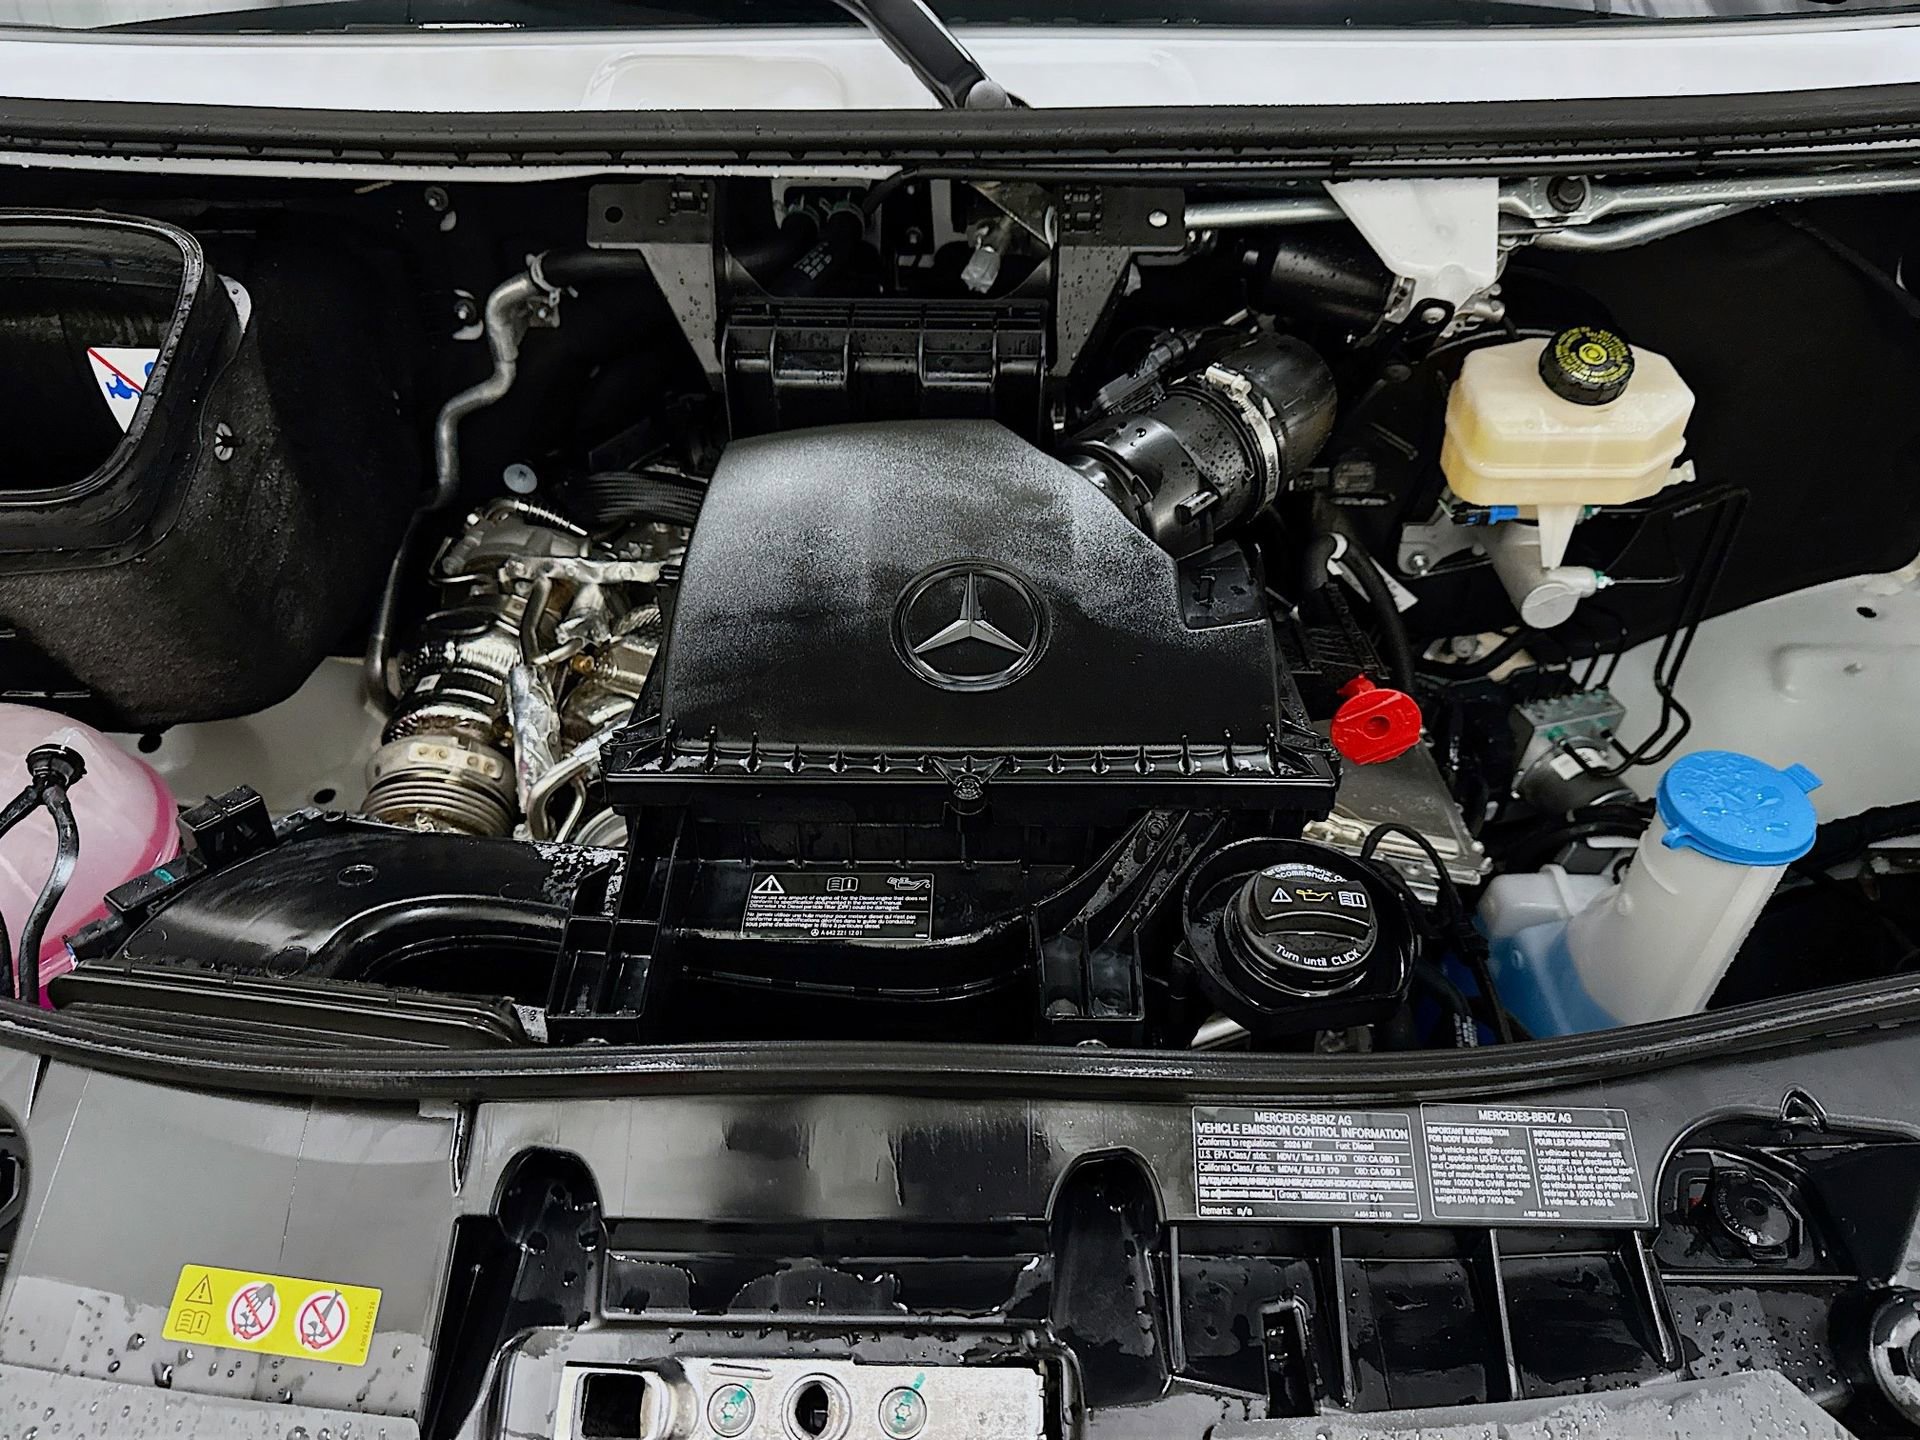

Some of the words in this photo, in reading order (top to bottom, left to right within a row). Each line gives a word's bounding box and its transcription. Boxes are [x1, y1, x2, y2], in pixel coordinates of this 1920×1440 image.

[1276, 944, 1299, 962] Turn
[1303, 957, 1327, 966] until
[1331, 948, 1361, 965] CLICK
[1254, 1112, 1336, 1125] MERCEDES-BENZ
[1338, 1115, 1352, 1126] AG
[1478, 1110, 1557, 1123] MERCEDES-BENZ
[1558, 1113, 1572, 1123] AG
[1197, 1122, 1240, 1134] VEHICLE
[1242, 1124, 1290, 1136] EMISSION
[1292, 1125, 1340, 1138] CONTROL
[1341, 1127, 1408, 1140] INFORMATION
[1427, 1126, 1464, 1135] IMPORTANT
[1465, 1128, 1510, 1136] INFORMATION
[1428, 1134, 1442, 1142] FOR
[1442, 1135, 1460, 1143] BODY
[1462, 1135, 1494, 1144] BUILDERS
[1534, 1138, 1552, 1146] POUR
[1554, 1138, 1565, 1146] LES
[1198, 1138, 1230, 1147] Conforms
[1232, 1139, 1238, 1147] to
[1302, 1140, 1312, 1149] MY
[1352, 1142, 1374, 1151] Diesel
[1198, 1151, 1212, 1159] U.S.
[1214, 1151, 1228, 1159] EPA
[1430, 1145, 1442, 1153] This
[1443, 1145, 1465, 1153] vehicle
[1466, 1146, 1478, 1154] and
[1479, 1146, 1499, 1155] engine
[1430, 1153, 1438, 1161] to
[1448, 1154, 1478, 1163] applicable
[1505, 1155, 1523, 1163] CARB
[1538, 1157, 1570, 1165] conformes
[1583, 1158, 1612, 1166] directives
[1198, 1163, 1230, 1172] California
[1304, 1166, 1326, 1174] SULEV
[1327, 1167, 1340, 1175] 170
[1474, 1163, 1508, 1172] regulations
[1517, 1164, 1528, 1172] the
[1538, 1165, 1556, 1173] CARB
[1432, 1170, 1446, 1178] time
[1456, 1171, 1494, 1179] manufacture
[1506, 1172, 1530, 1180] vehicles
[1598, 1175, 1630, 1183] production
[1434, 1178, 1452, 1186] under
[1454, 1179, 1474, 1187] 10000
[1486, 1180, 1505, 1188] GVWR
[1506, 1180, 1518, 1188] and
[1278, 1191, 1300, 1201] Group:
[1370, 1193, 1384, 1202] n/a
[1440, 1187, 1470, 1195] maximum
[1472, 1188, 1500, 1196] unloaded
[1576, 1190, 1596, 1198] 10000
[1435, 1195, 1456, 1204] weight
[1200, 1206, 1233, 1215] Remarks:
[1237, 1206, 1253, 1216] n/a
